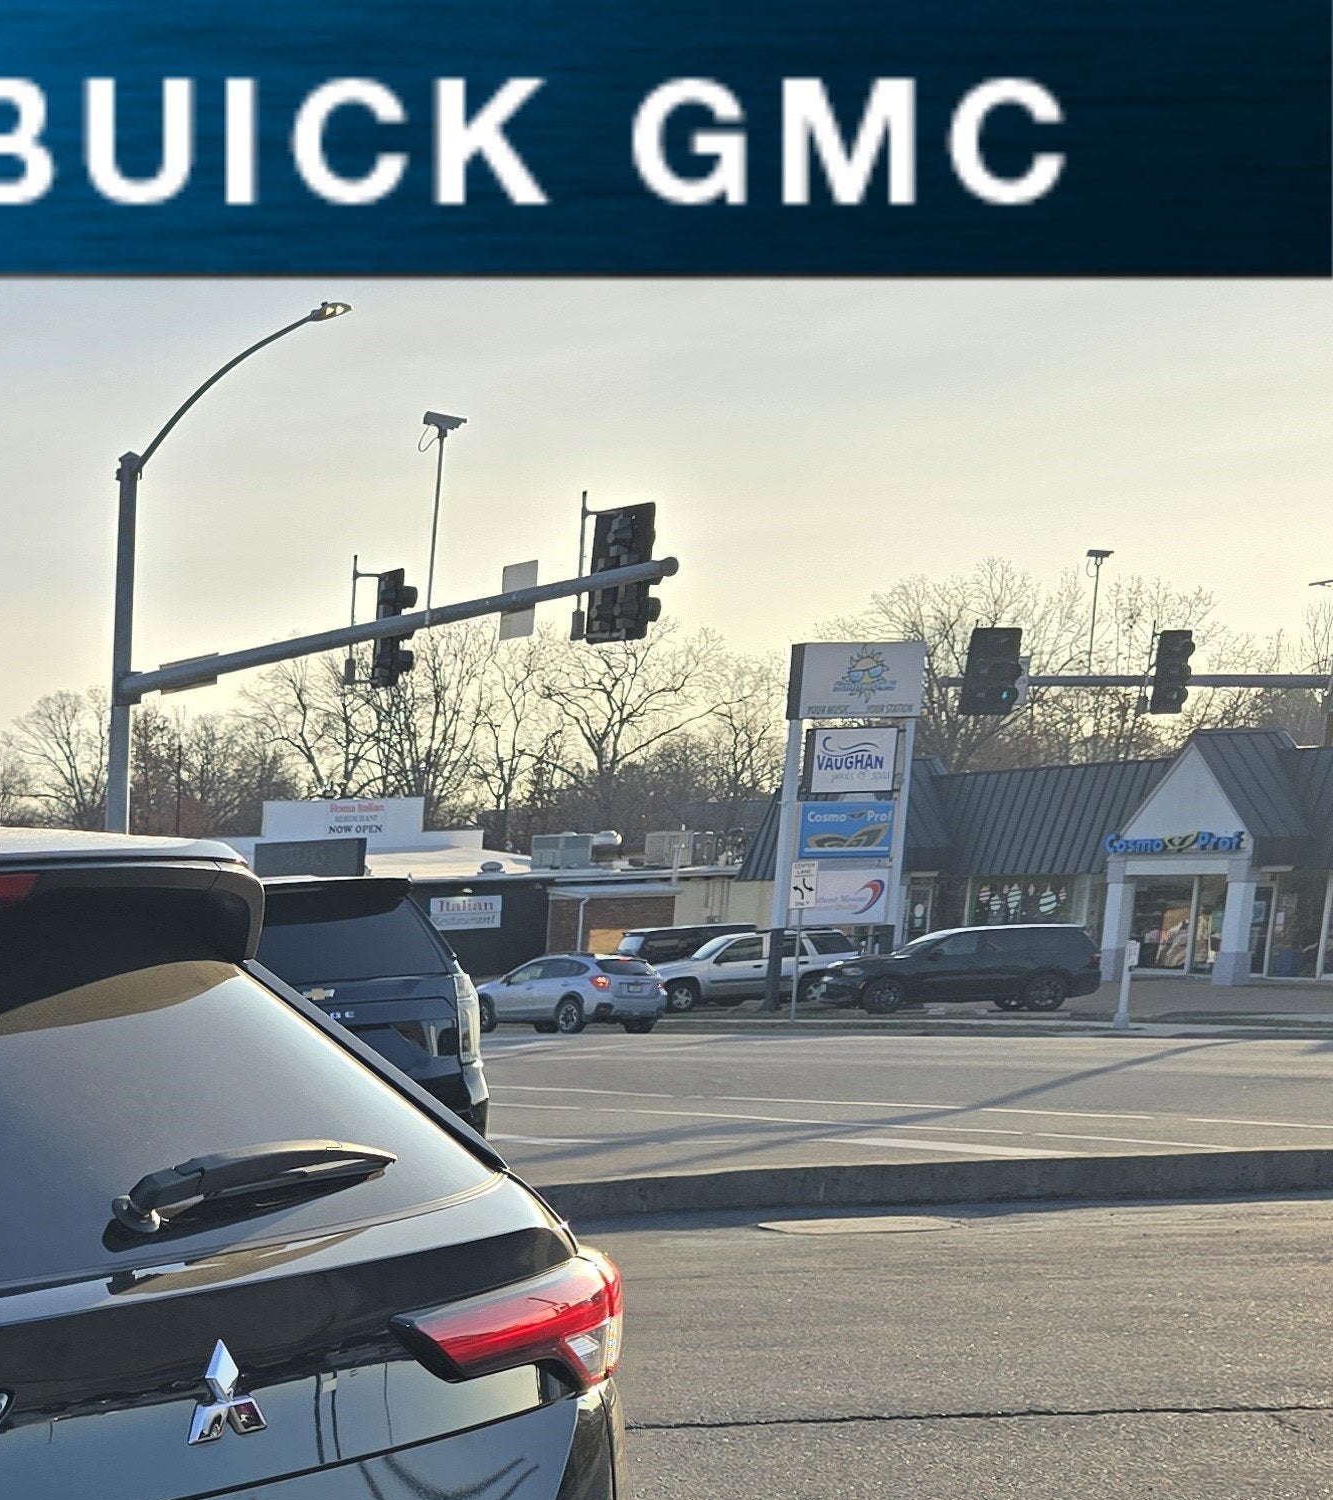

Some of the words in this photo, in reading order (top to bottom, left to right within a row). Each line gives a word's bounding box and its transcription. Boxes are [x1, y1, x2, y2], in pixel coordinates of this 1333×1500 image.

[817, 754, 884, 770] VAUGHAN
[330, 804, 355, 812] Roma
[358, 803, 384, 812] Italian
[808, 811, 847, 823] Cosmo
[867, 810, 892, 822] Prof
[329, 825, 352, 834] NOW
[356, 825, 383, 833] OPEN
[1106, 832, 1164, 853] Cosmo
[1197, 831, 1245, 851] Prof
[438, 901, 493, 912] Italian
